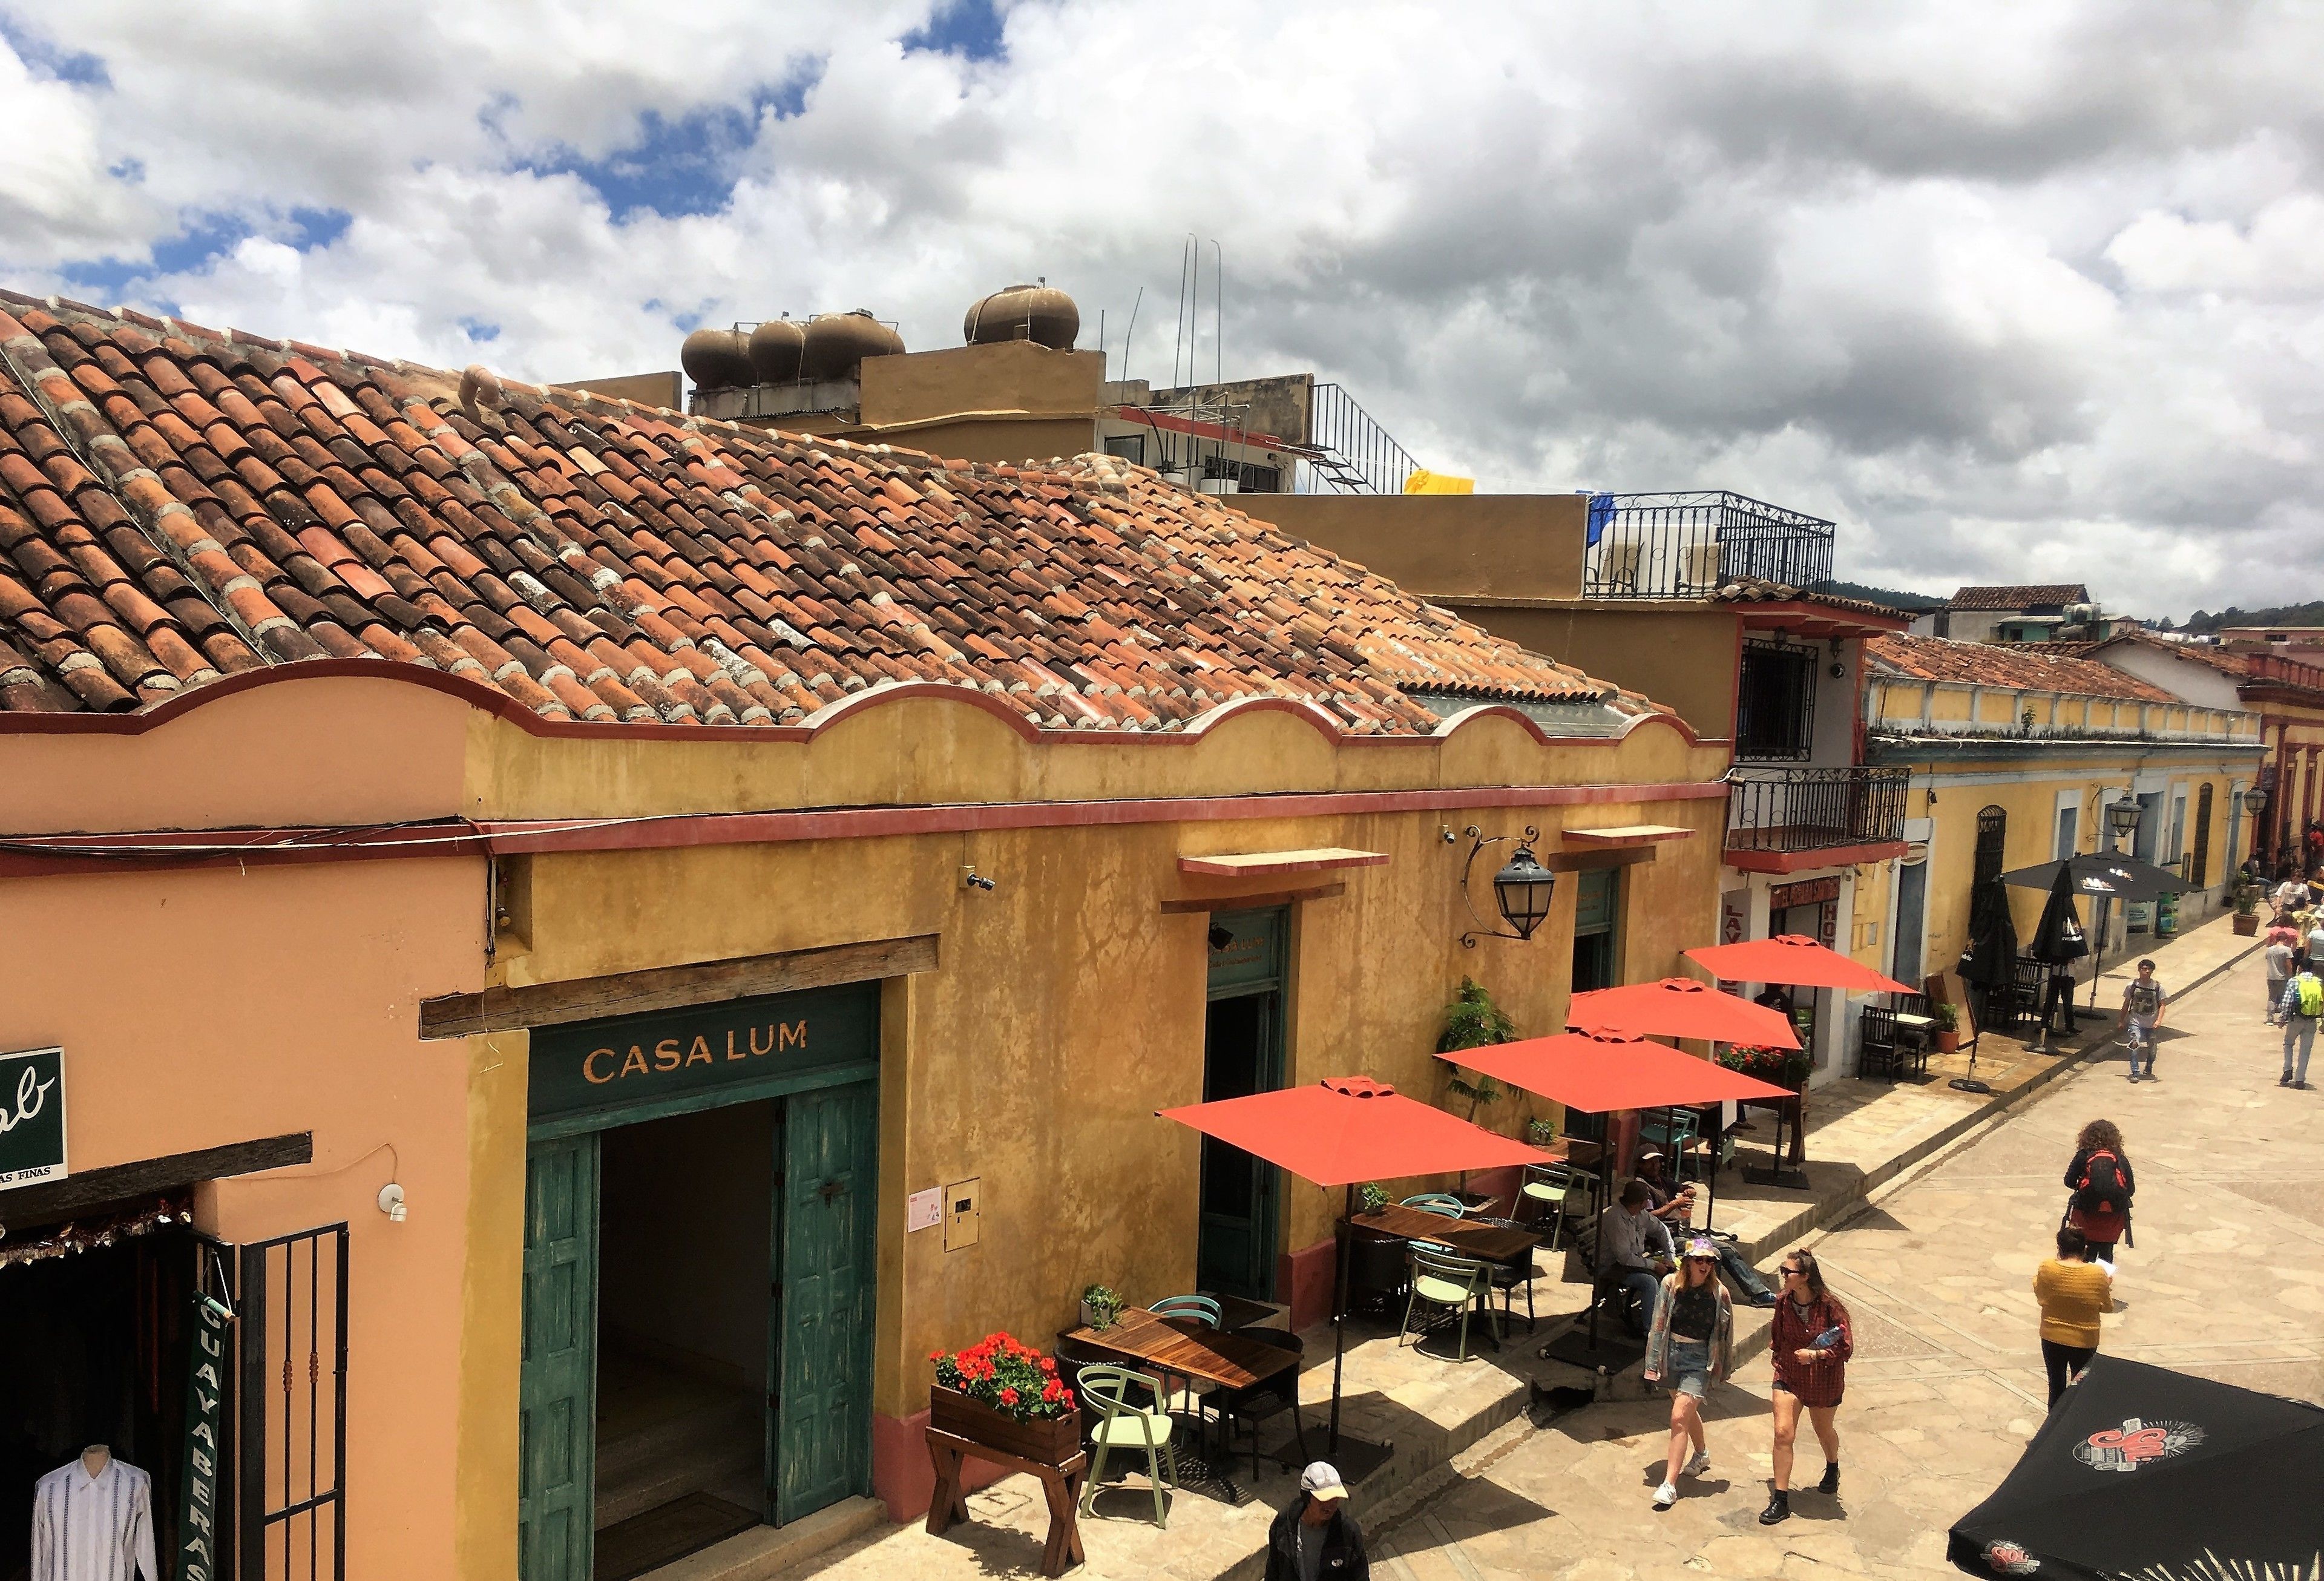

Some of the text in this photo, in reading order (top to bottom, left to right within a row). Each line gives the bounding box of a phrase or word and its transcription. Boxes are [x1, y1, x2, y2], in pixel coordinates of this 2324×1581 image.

[1823, 904, 1837, 950] HOT
[583, 1019, 807, 1084] CASA LUM
[18, 1167, 51, 1180] FINAS
